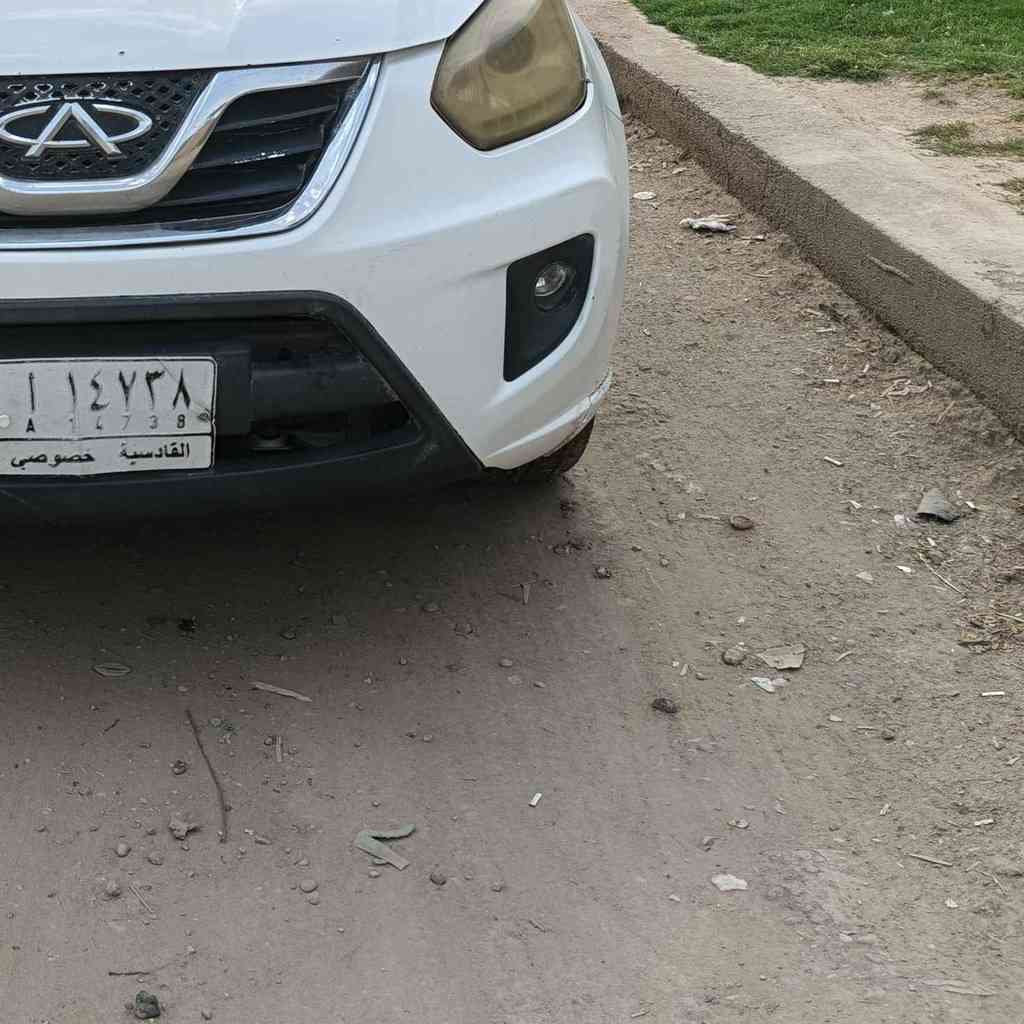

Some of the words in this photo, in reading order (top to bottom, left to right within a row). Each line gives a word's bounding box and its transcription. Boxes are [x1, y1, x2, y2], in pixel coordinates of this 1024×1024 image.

[68, 368, 191, 411] ١٤٧٣٨
[26, 418, 36, 432] A
[10, 449, 95, 470] خصوصي
[119, 442, 190, 465] القادسية
